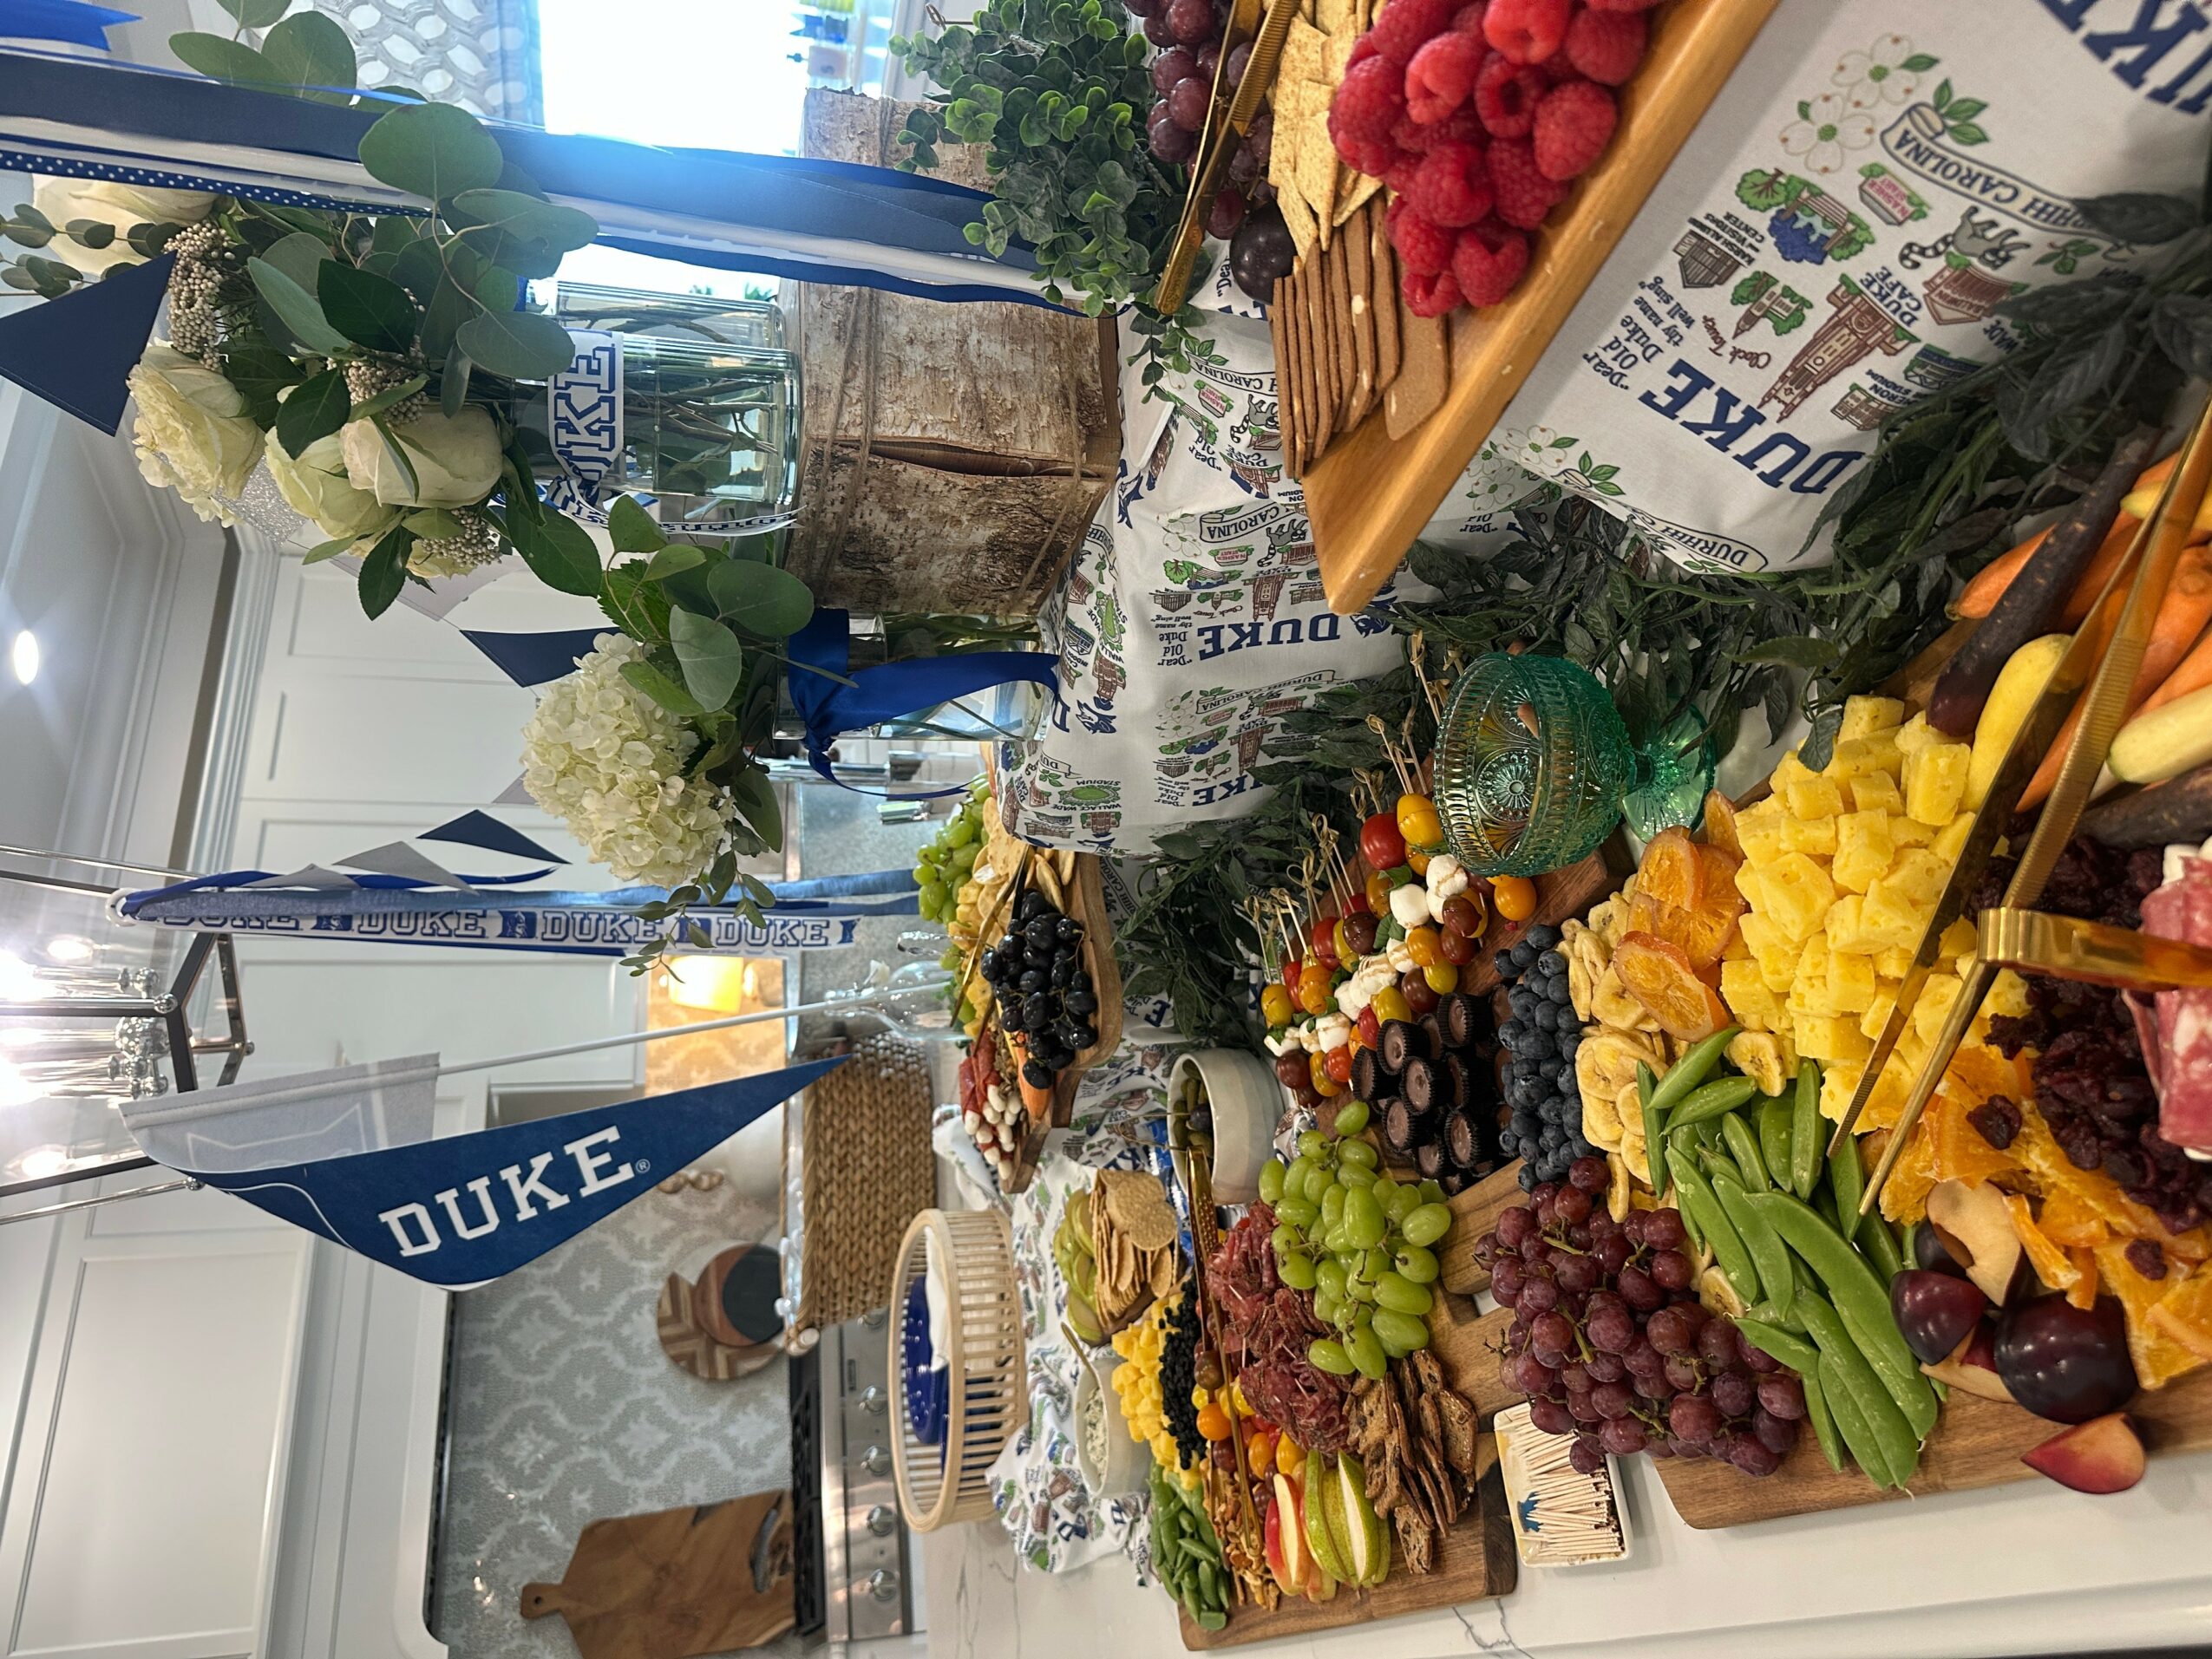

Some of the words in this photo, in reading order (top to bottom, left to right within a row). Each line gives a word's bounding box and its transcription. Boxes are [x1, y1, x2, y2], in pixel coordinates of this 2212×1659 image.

[1893, 128, 2020, 204] CAROLINA
[1866, 179, 1909, 217] NASHER
[1687, 217, 1723, 245] ALUMNI
[1704, 212, 1751, 248] VISITORS
[1723, 212, 1764, 244] CENTER
[1721, 238, 1756, 265] KARSH
[1217, 256, 1232, 297] "Dea
[1875, 266, 1921, 312] CAFE
[1633, 296, 1665, 328] name
[1666, 300, 1696, 330] well
[1859, 272, 1918, 328] DUKE
[1620, 315, 1664, 363] Duke
[1662, 323, 1684, 347] thy
[1702, 315, 1726, 357] Tower
[1982, 319, 2019, 355] WADE
[1598, 336, 1639, 370] Old
[1729, 345, 1772, 369] Clock
[1194, 362, 1264, 390] CAROLINA
[1865, 369, 1912, 396] STADIUM
[1638, 358, 1865, 494] DUKE
[1207, 505, 1280, 539] CAROLINA
[1216, 553, 1247, 562] NASHER
[1219, 604, 1244, 617] Clock
[1159, 630, 1188, 643] Duke
[1163, 643, 1183, 656] Old
[1197, 613, 1340, 661] DUKE
[1202, 686, 1265, 711] CAROLINA
[1235, 719, 1269, 734] DUKE
[1158, 787, 1185, 797] Duke
[1160, 793, 1179, 801] Old
[1050, 803, 1077, 812] WADE
[1080, 803, 1122, 812] WALLACE
[358, 909, 488, 938] DUKE
[541, 910, 664, 944] DUKE
[716, 916, 830, 947] DUKE
[377, 1125, 635, 1257] DUKE
